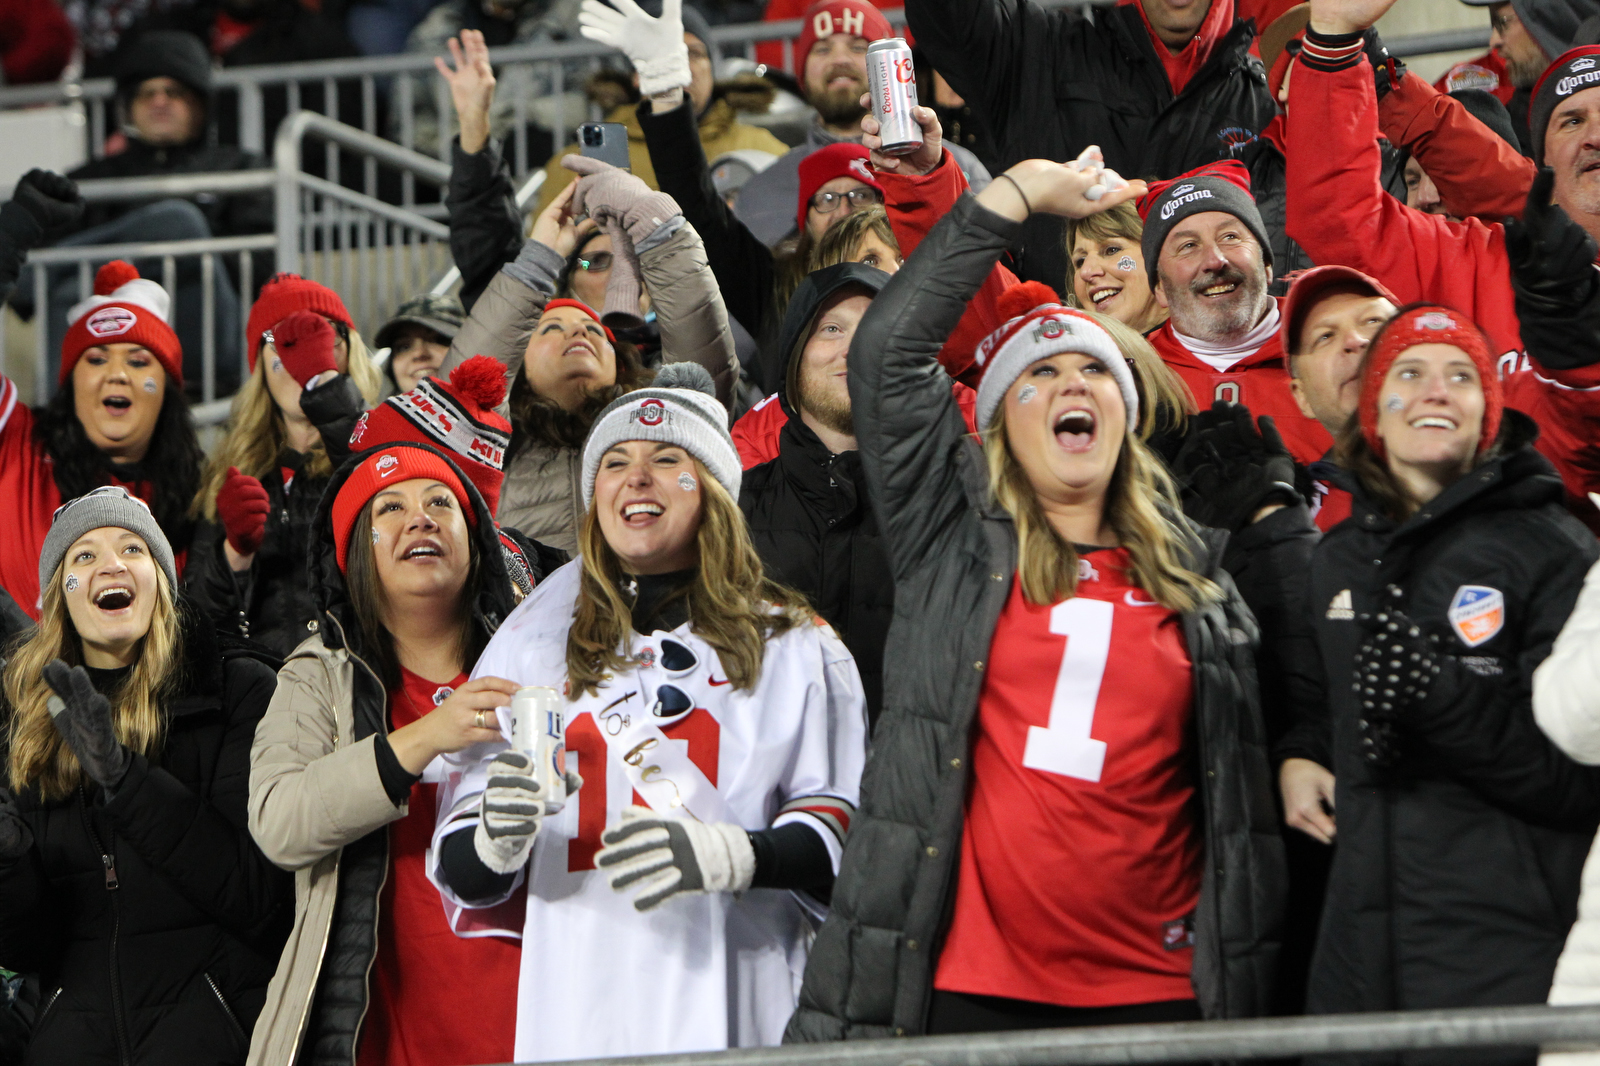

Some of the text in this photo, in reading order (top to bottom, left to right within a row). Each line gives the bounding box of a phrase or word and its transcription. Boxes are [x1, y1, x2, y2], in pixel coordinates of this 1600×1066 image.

[813, 8, 864, 38] O-H
[881, 61, 893, 114] Coors LIGHT
[1161, 189, 1213, 220] Corona
[1215, 381, 1240, 408] O
[629, 405, 675, 425] OHIO STATE
[1023, 598, 1114, 783] 1
